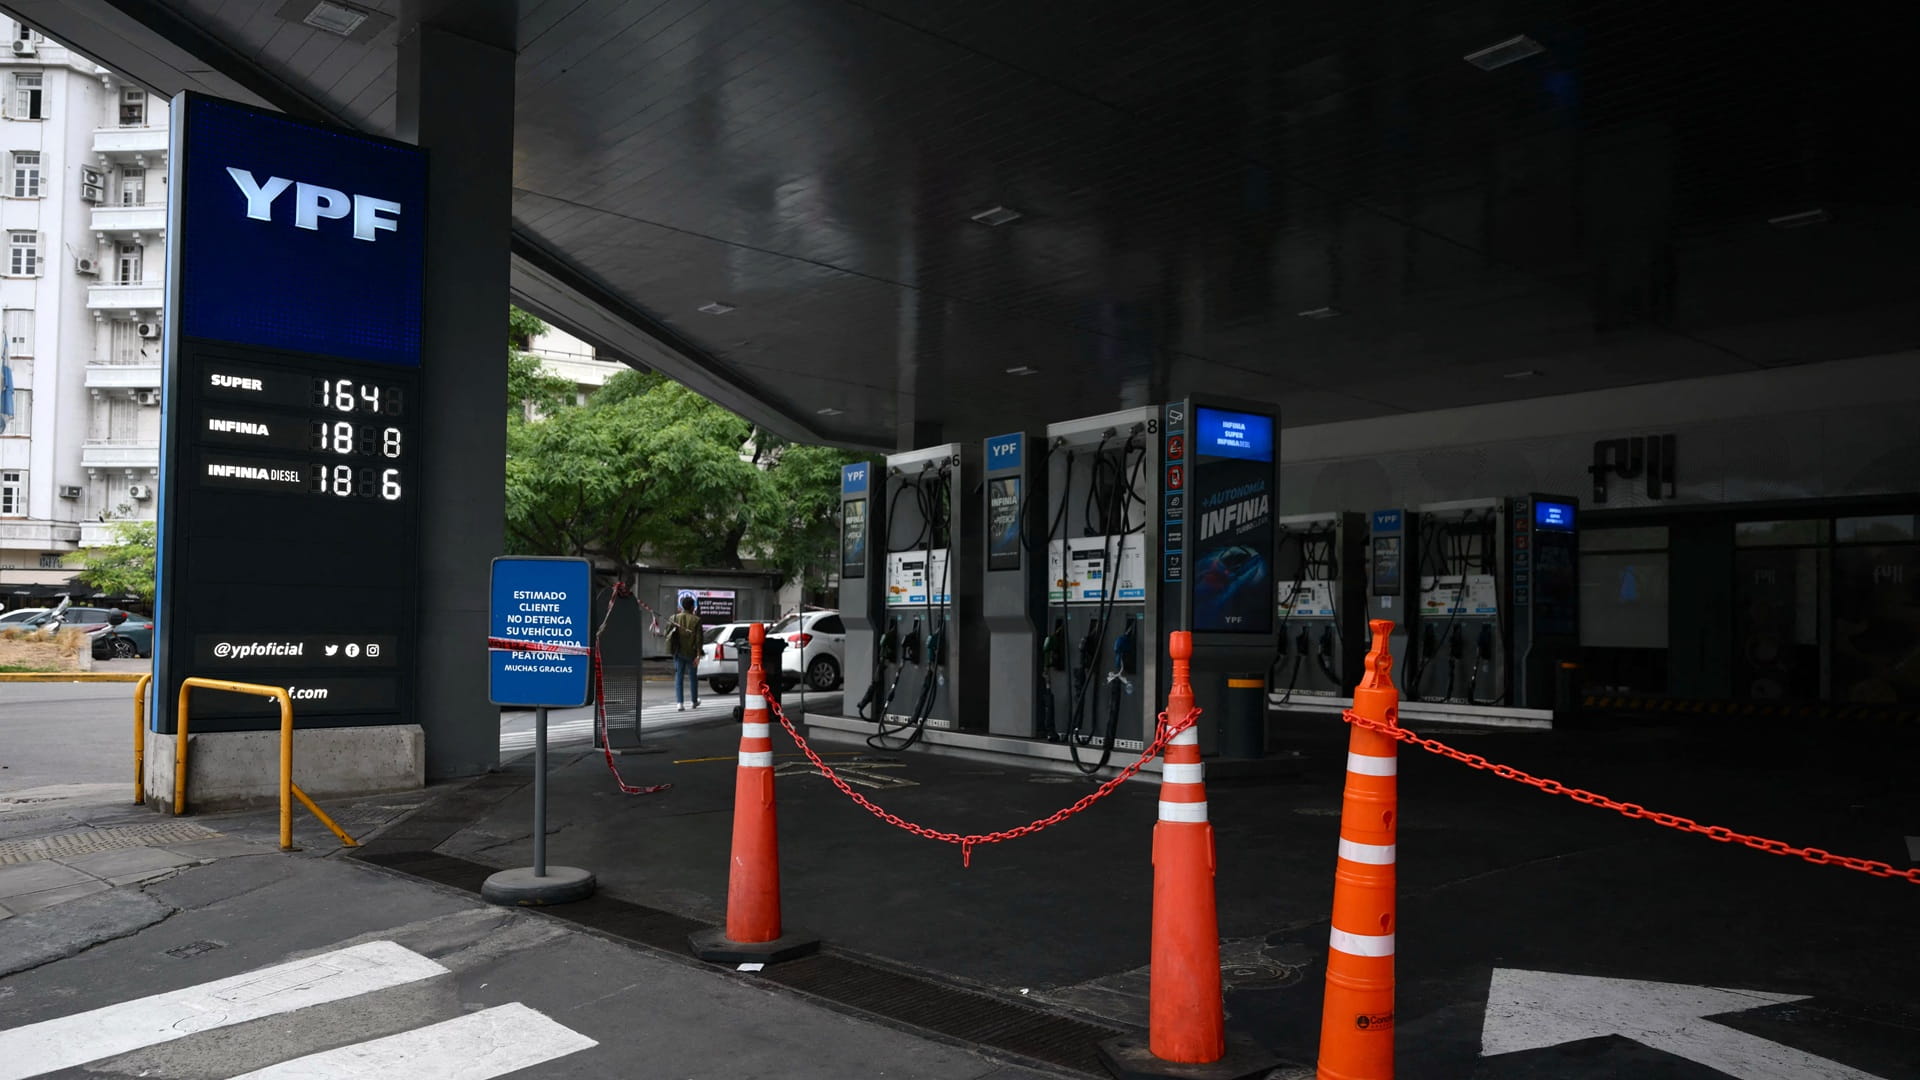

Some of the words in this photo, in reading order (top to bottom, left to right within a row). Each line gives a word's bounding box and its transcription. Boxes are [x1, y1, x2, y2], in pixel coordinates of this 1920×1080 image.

[226, 166, 401, 241] YPF
[211, 374, 263, 391] SUPER
[323, 380, 379, 412] 164
[209, 419, 269, 436] INFINIA
[1147, 419, 1157, 434] 8
[1224, 431, 1244, 439] SUPER
[993, 443, 1017, 457] YPF
[952, 454, 960, 467] 6
[208, 464, 270, 481] INFINIA
[270, 470, 301, 483] DIESEL
[847, 471, 865, 483] YPF
[991, 495, 1018, 507] INFINIA
[1200, 494, 1269, 541] INFINIA
[1378, 514, 1398, 524] YPF
[513, 591, 567, 601] ESTIMADO
[519, 603, 560, 612] CLIENTE
[507, 615, 522, 624] NO
[524, 615, 572, 625] DETENGA
[1224, 615, 1243, 624] YPF
[506, 626, 519, 636] SU
[521, 625, 573, 637] VEHÍCULO
[214, 642, 304, 659] @ypfoficial
[511, 651, 566, 661] PEATONAL
[504, 664, 538, 672] MUCHAS
[539, 665, 573, 673] GRACIAS
